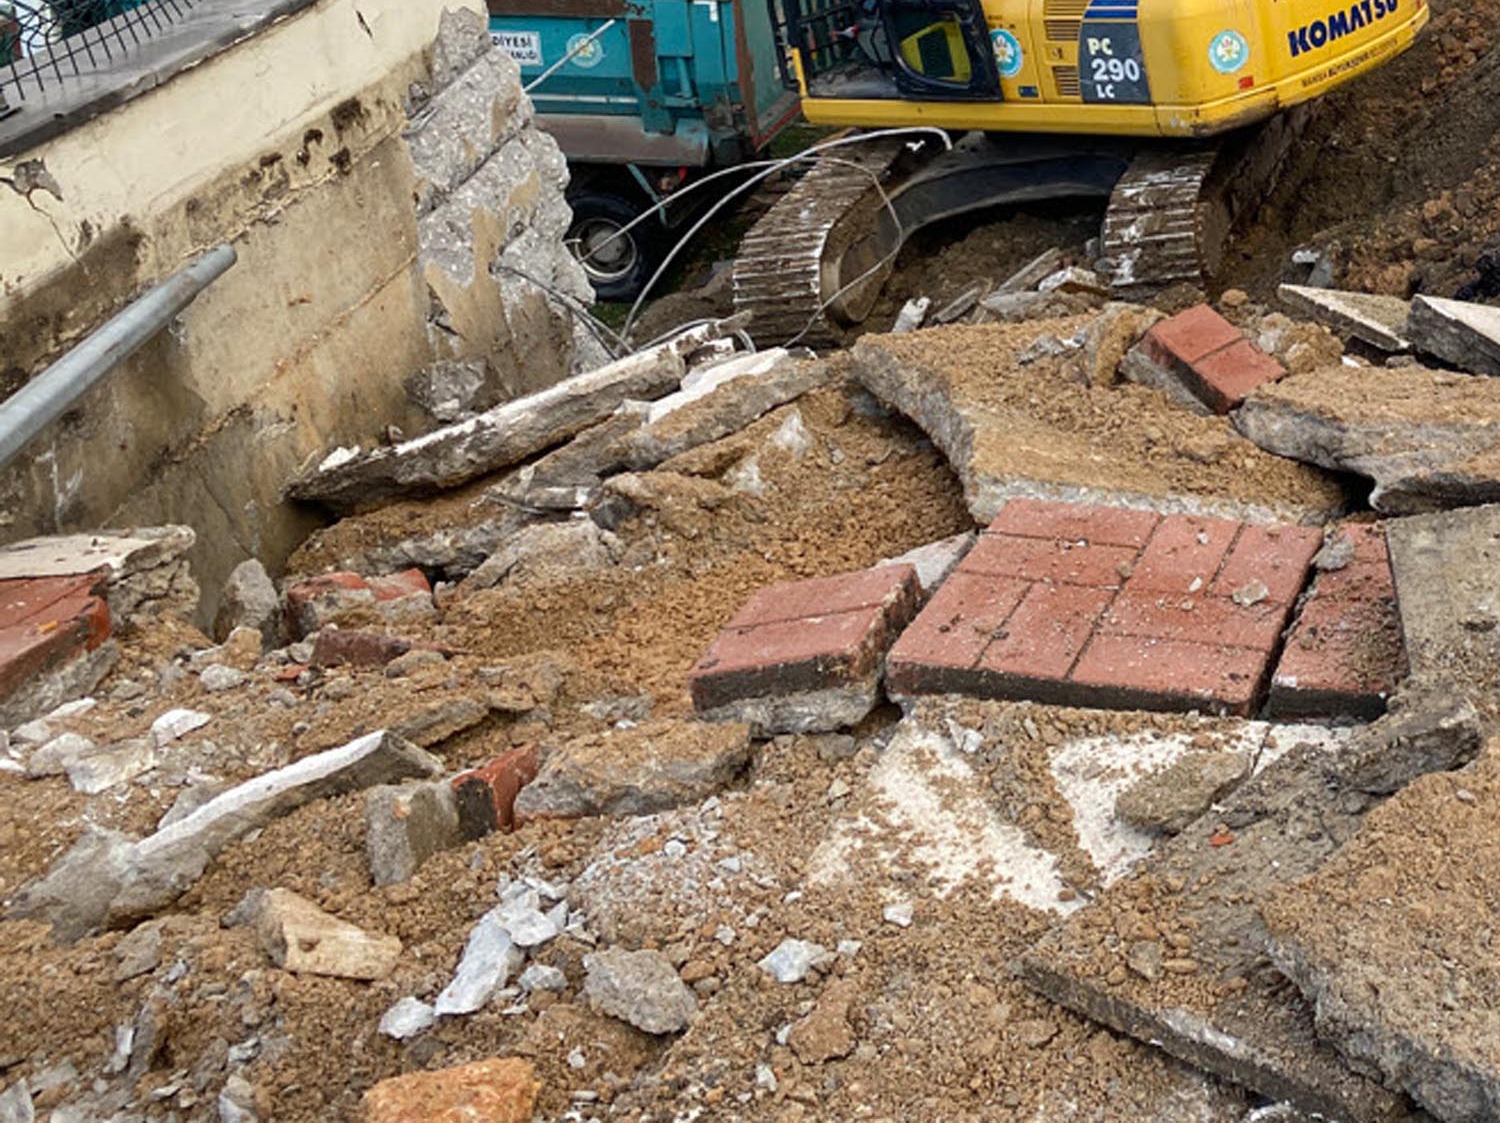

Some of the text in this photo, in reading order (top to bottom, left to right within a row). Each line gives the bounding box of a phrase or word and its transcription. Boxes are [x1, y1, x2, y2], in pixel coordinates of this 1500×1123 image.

[492, 35, 532, 48] DİYESİ
[1087, 38, 1113, 55] PC
[1091, 58, 1141, 82] 290
[1096, 85, 1115, 99] LC
